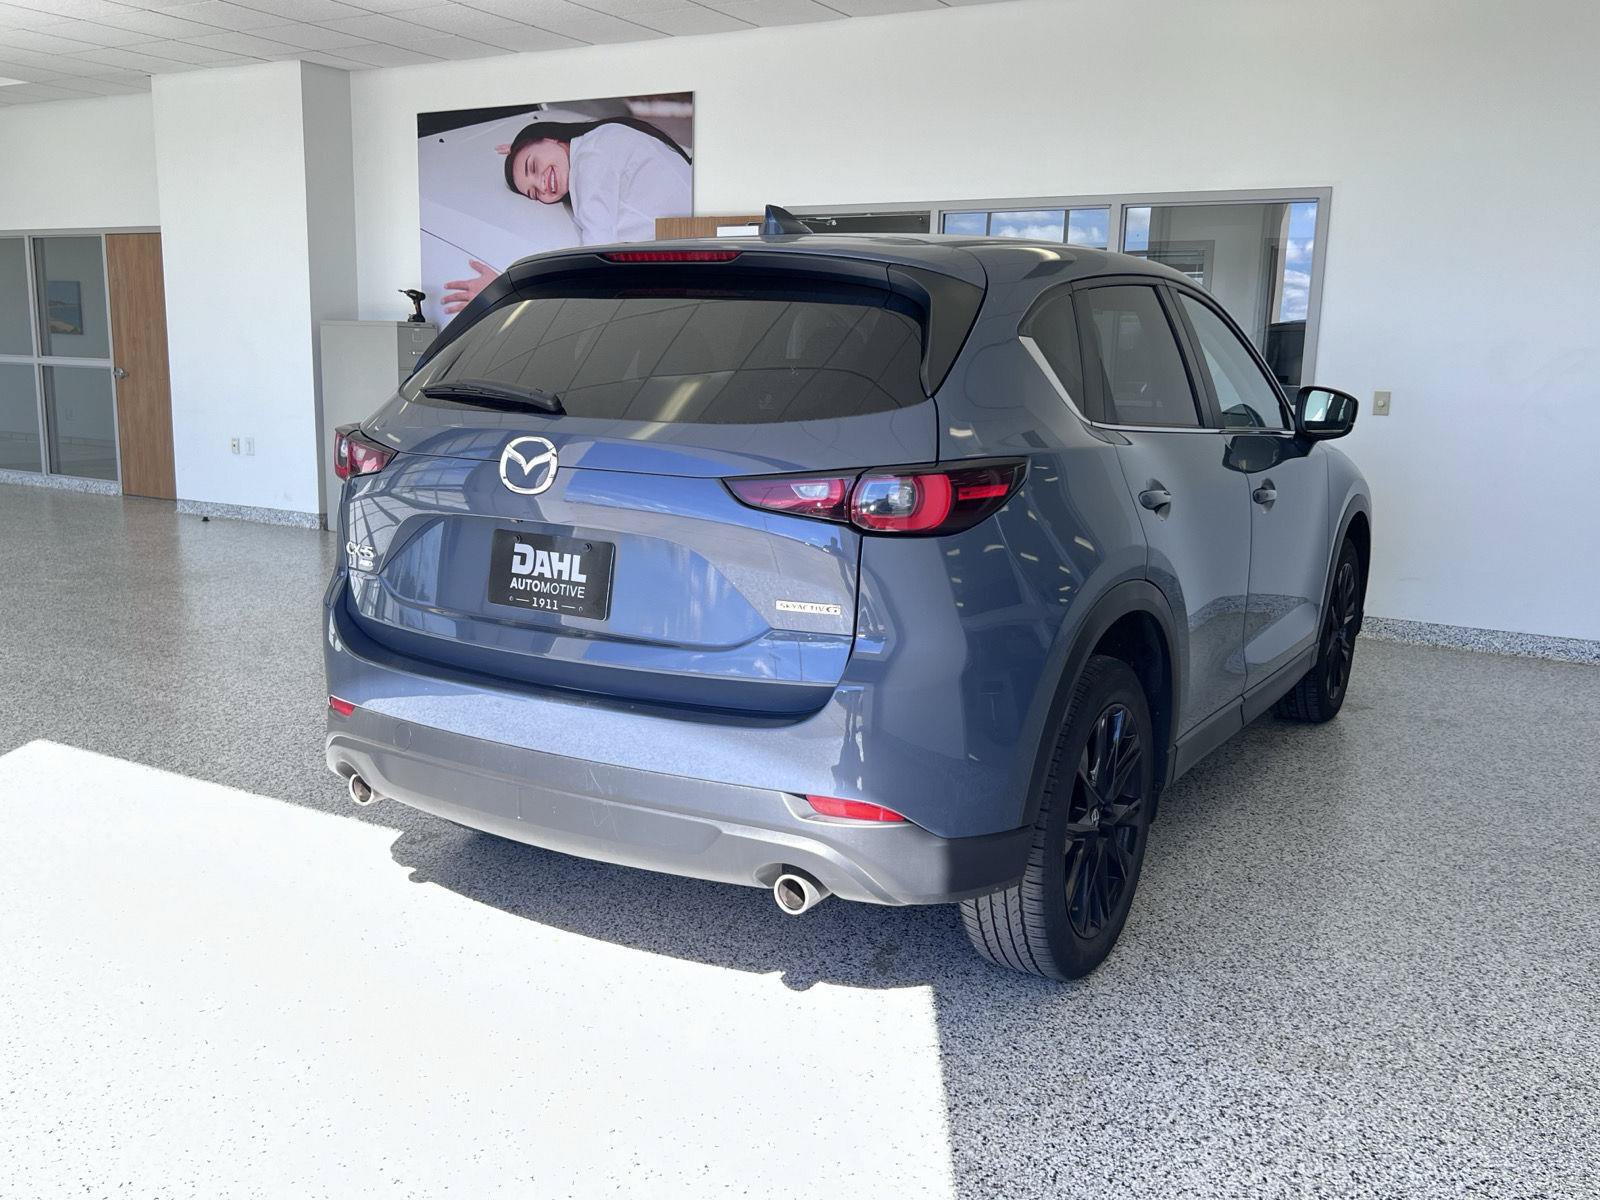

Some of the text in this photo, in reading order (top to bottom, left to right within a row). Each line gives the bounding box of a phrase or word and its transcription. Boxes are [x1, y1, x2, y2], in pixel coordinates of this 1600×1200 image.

[511, 542, 587, 583] DAHL
[509, 577, 586, 599] AUTOMOTIVE
[532, 597, 559, 610] 1911
